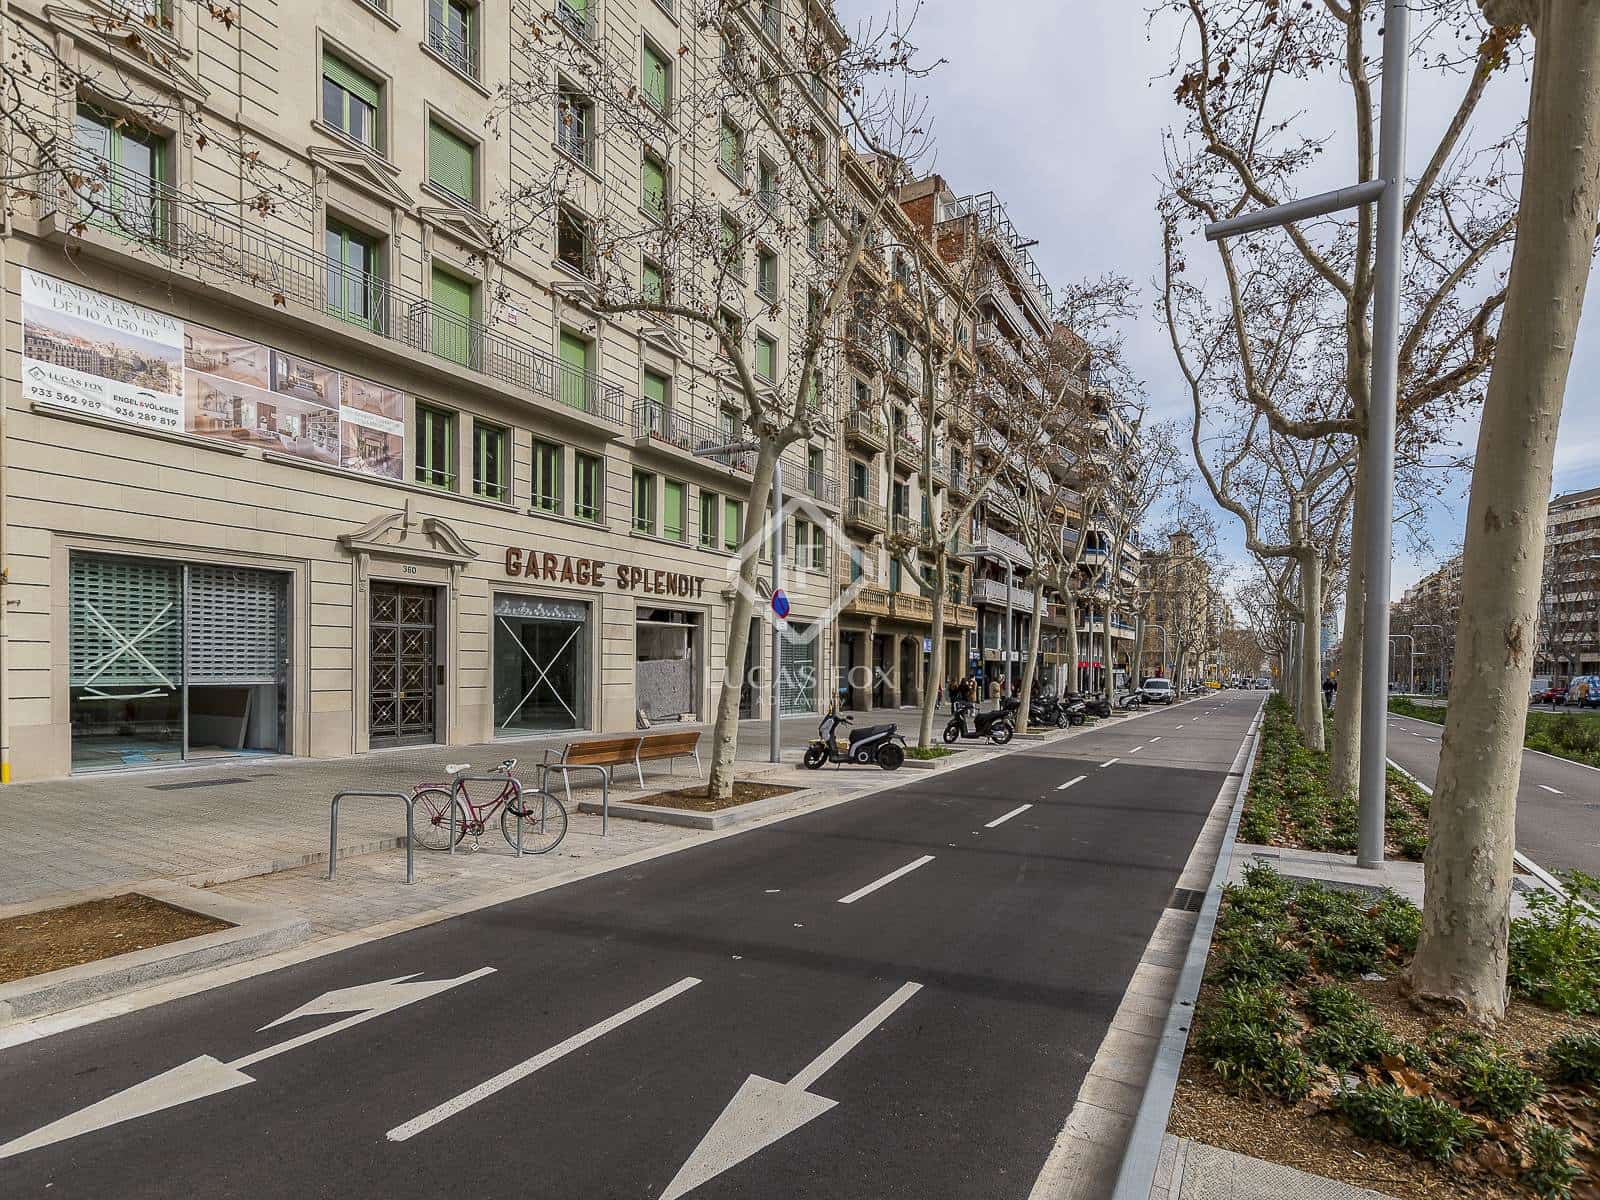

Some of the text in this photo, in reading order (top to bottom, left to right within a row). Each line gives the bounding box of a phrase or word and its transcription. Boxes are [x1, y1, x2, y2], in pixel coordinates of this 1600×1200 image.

[30, 274, 177, 331] VIVIENDAS EN VENTA
[52, 297, 73, 313] DE
[77, 305, 101, 321] 140
[103, 314, 113, 326] A
[116, 318, 138, 332] 150
[48, 372, 82, 386] LUCAS
[84, 381, 104, 392] FOX
[31, 386, 53, 398] 933
[56, 391, 78, 405] 562
[81, 398, 102, 409] 989
[115, 406, 177, 427] 936 289 819
[402, 565, 417, 575] 360
[505, 547, 705, 599] GARAGE SPLENDIT
